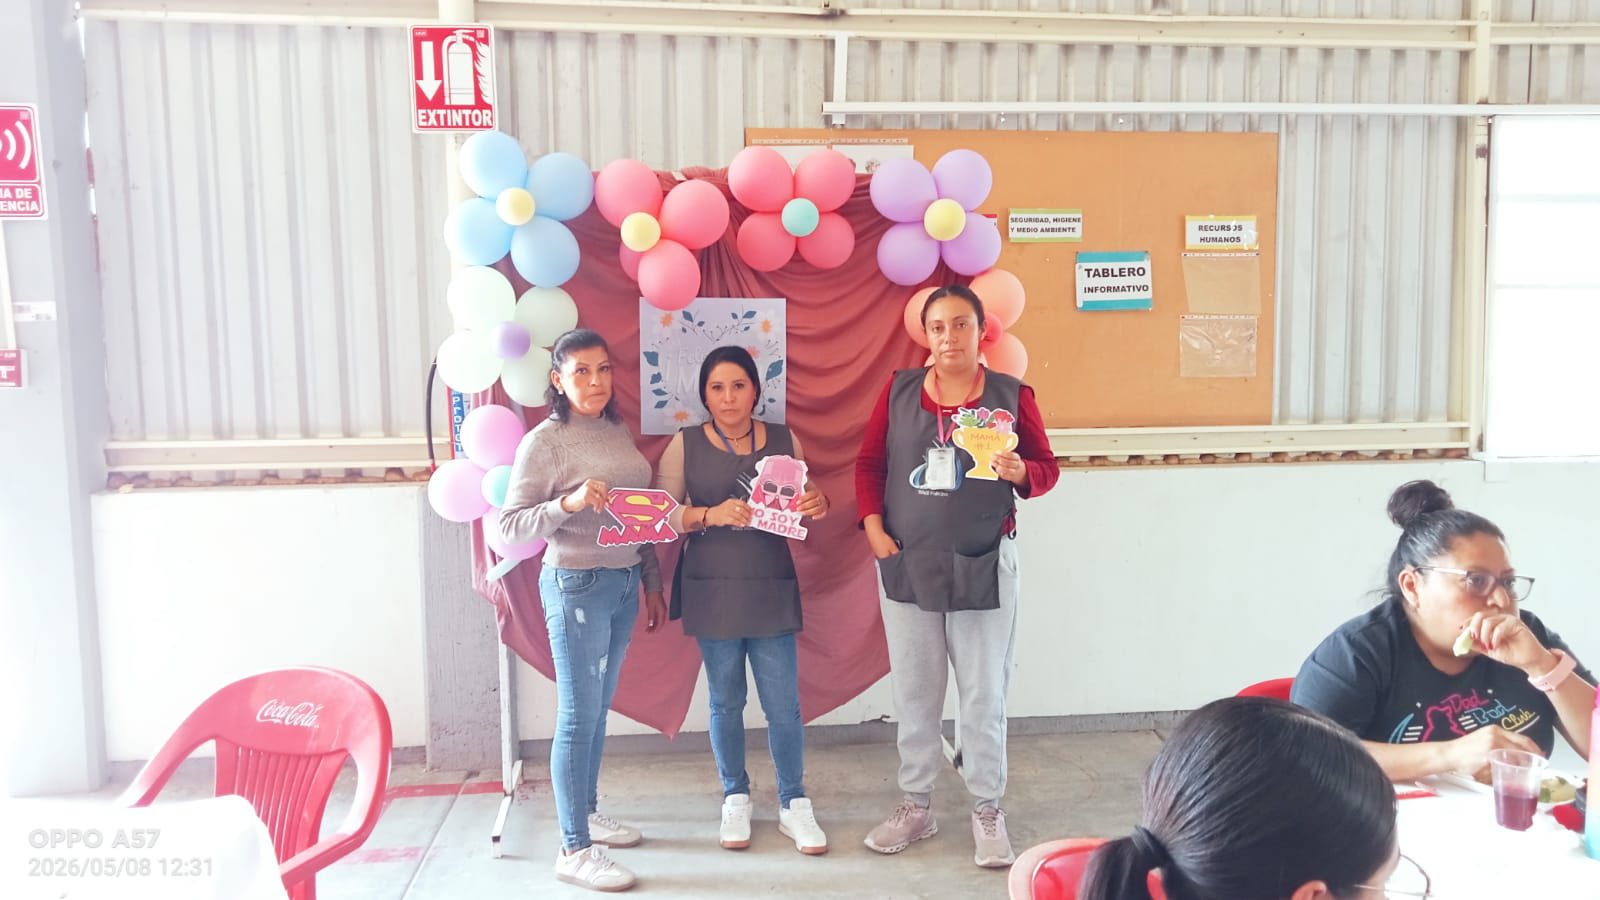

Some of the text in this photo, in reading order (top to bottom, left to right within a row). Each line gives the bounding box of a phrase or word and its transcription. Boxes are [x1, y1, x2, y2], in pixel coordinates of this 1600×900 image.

[418, 109, 493, 127] EXTINTOR
[15, 188, 33, 199] DE
[1084, 267, 1146, 278] TABLERO
[1084, 284, 1149, 294] INFORMATIVO
[769, 511, 798, 526] SOY
[757, 520, 806, 539] MADRE
[1501, 708, 1536, 731] Club
